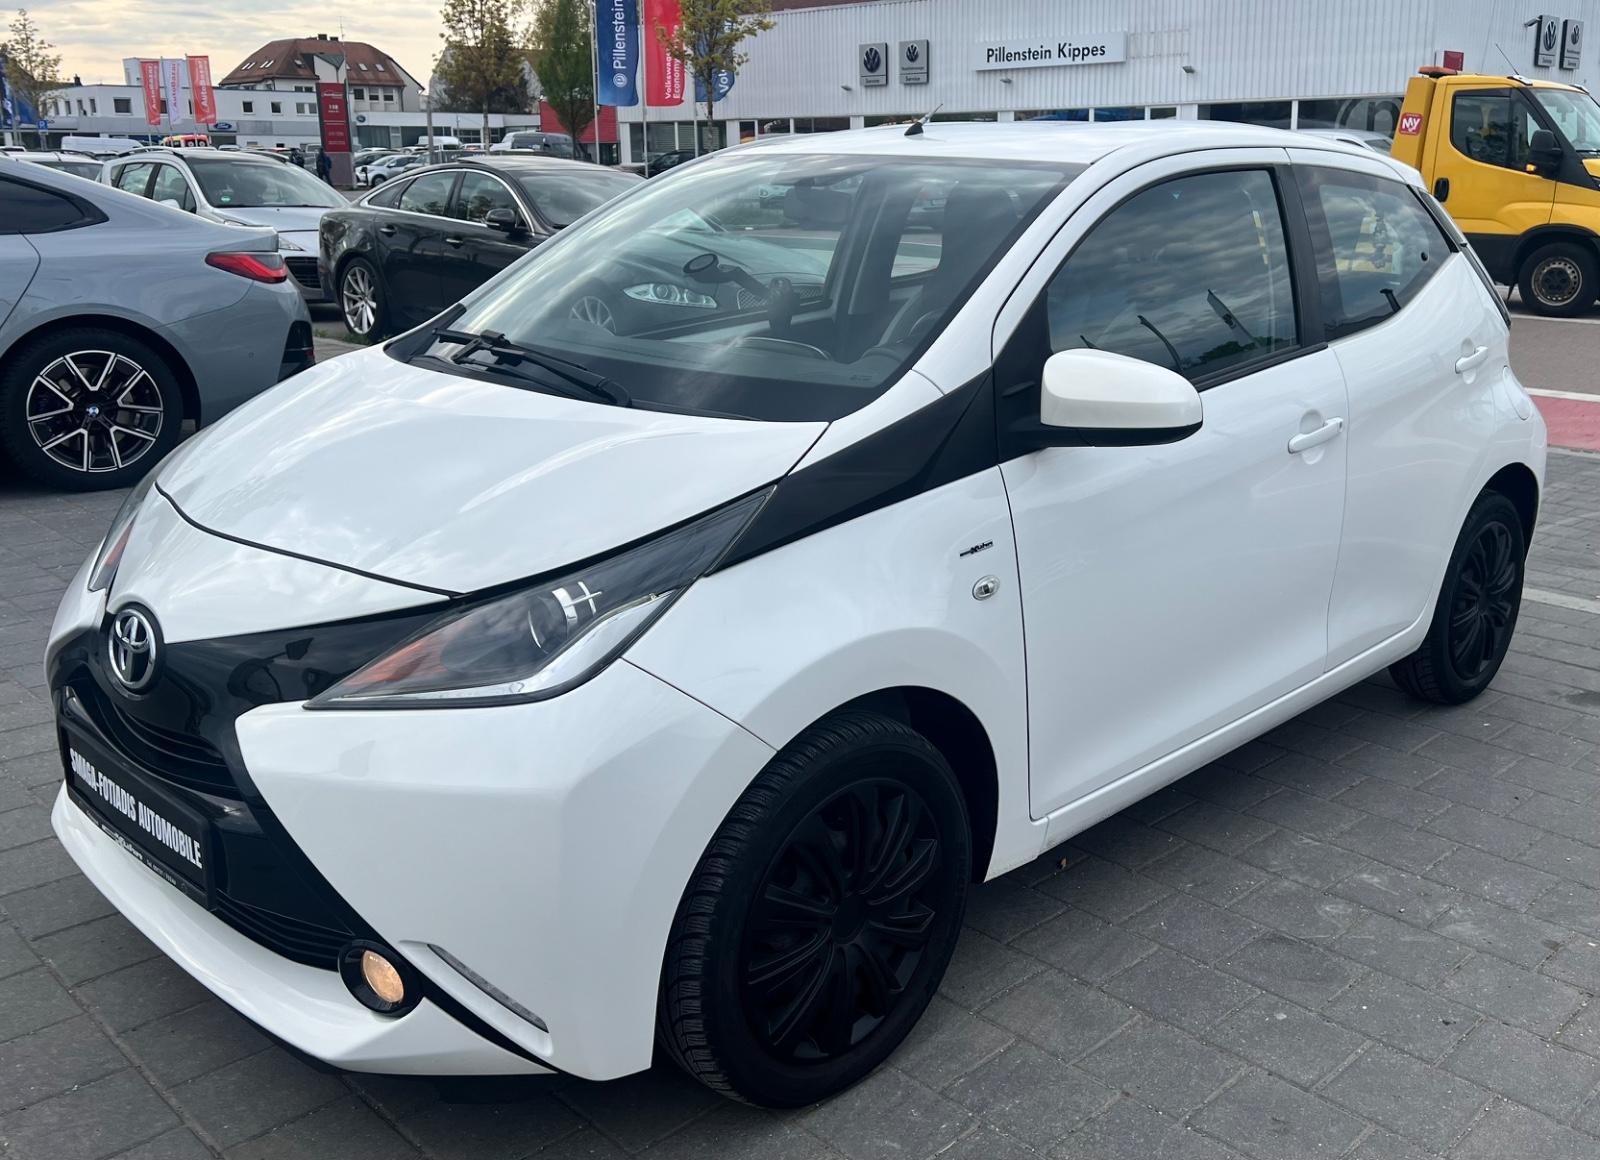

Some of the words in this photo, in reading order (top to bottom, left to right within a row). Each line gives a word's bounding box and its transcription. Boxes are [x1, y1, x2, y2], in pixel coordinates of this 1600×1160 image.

[611, 0, 627, 69] Pillenstein
[986, 45, 1052, 63] Pillenstein
[1057, 42, 1106, 62] Kippes
[70, 747, 136, 822] SMAGA-FOTIADIS
[138, 801, 203, 870] AUTOMOBILE
